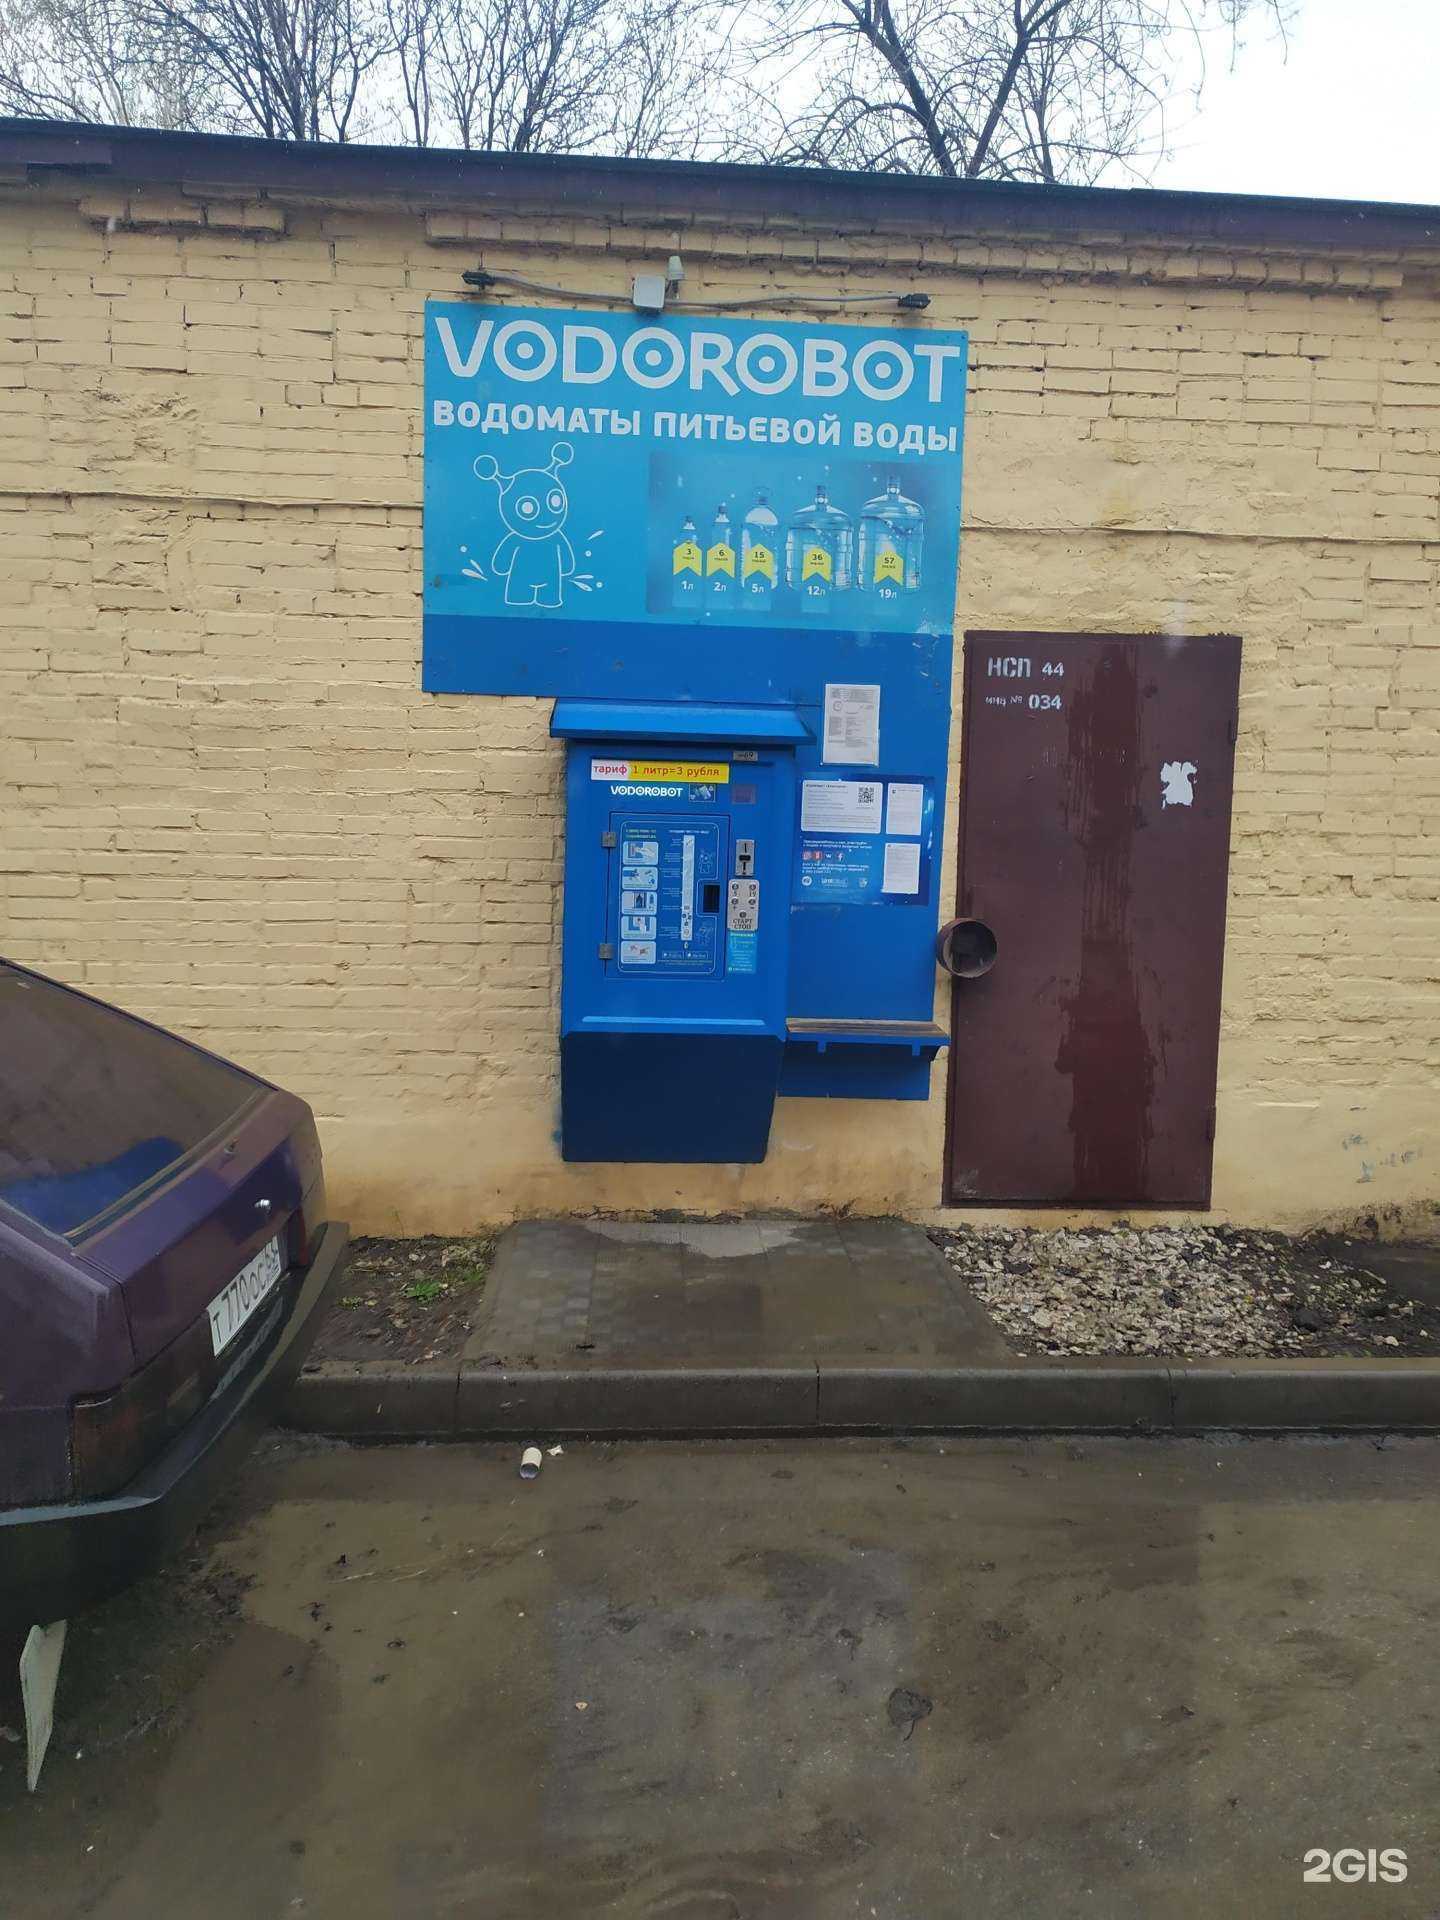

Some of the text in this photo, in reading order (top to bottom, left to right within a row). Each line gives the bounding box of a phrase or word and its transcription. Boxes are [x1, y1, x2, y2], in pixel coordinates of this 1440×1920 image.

[434, 317, 961, 403] VODOROBOT
[433, 400, 957, 456] ВОДОМАТЫ ПИТЬЕВОЙ ВОДЫ
[718, 549, 725, 557] 6
[754, 551, 765, 559] 15
[811, 553, 823, 561] 36
[680, 580, 694, 591] 1л
[713, 582, 727, 592] 2л
[751, 584, 765, 593] 5л
[807, 585, 826, 597] 12л
[878, 589, 897, 599] 19л
[987, 657, 1065, 678] НСП 44
[1028, 694, 1063, 710] 034
[593, 764, 628, 776] тариф
[632, 765, 638, 774] 1
[686, 767, 720, 778] рубля
[610, 785, 684, 797] VODOROBOT
